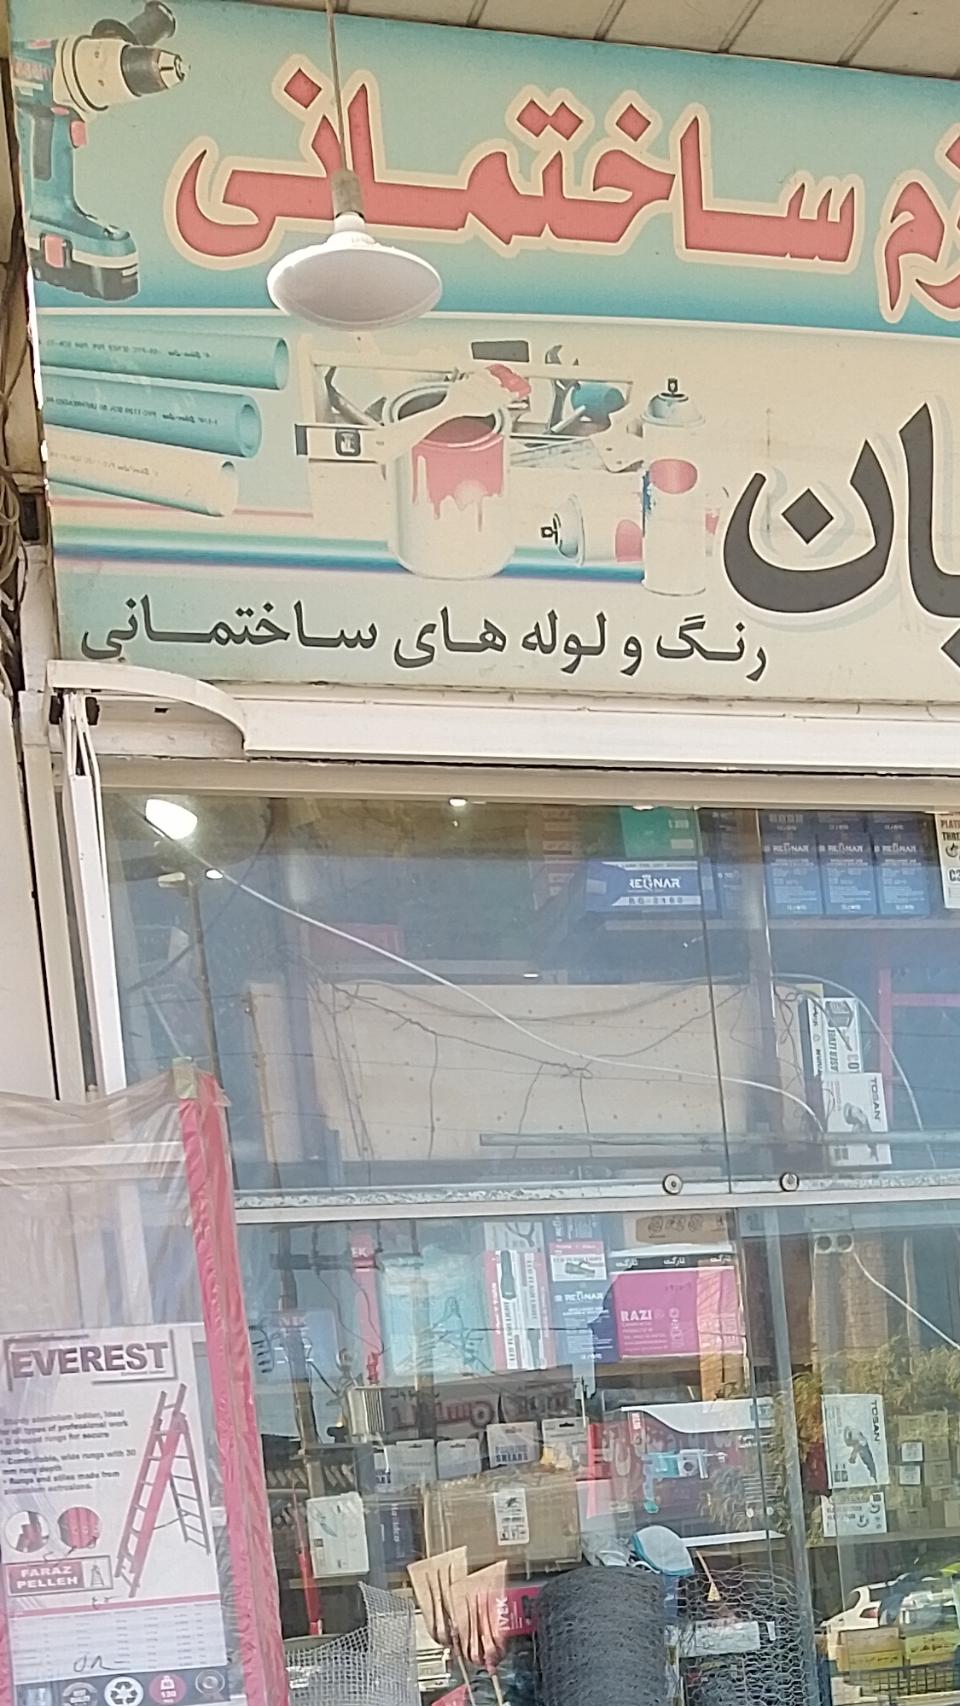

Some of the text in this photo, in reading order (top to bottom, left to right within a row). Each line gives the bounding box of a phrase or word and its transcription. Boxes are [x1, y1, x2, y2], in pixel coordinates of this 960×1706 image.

[177, 67, 856, 262] ساختمانی
[80, 593, 768, 682] رنگ و لوله های ساختمانی
[870, 1077, 881, 1121] TOSAN
[620, 1309, 653, 1322] RAZI
[11, 1341, 168, 1379] EVEREST
[871, 1399, 881, 1443] TOSAN
[16, 1576, 78, 1590] PELLEH
[20, 1565, 73, 1578] FARAZ
